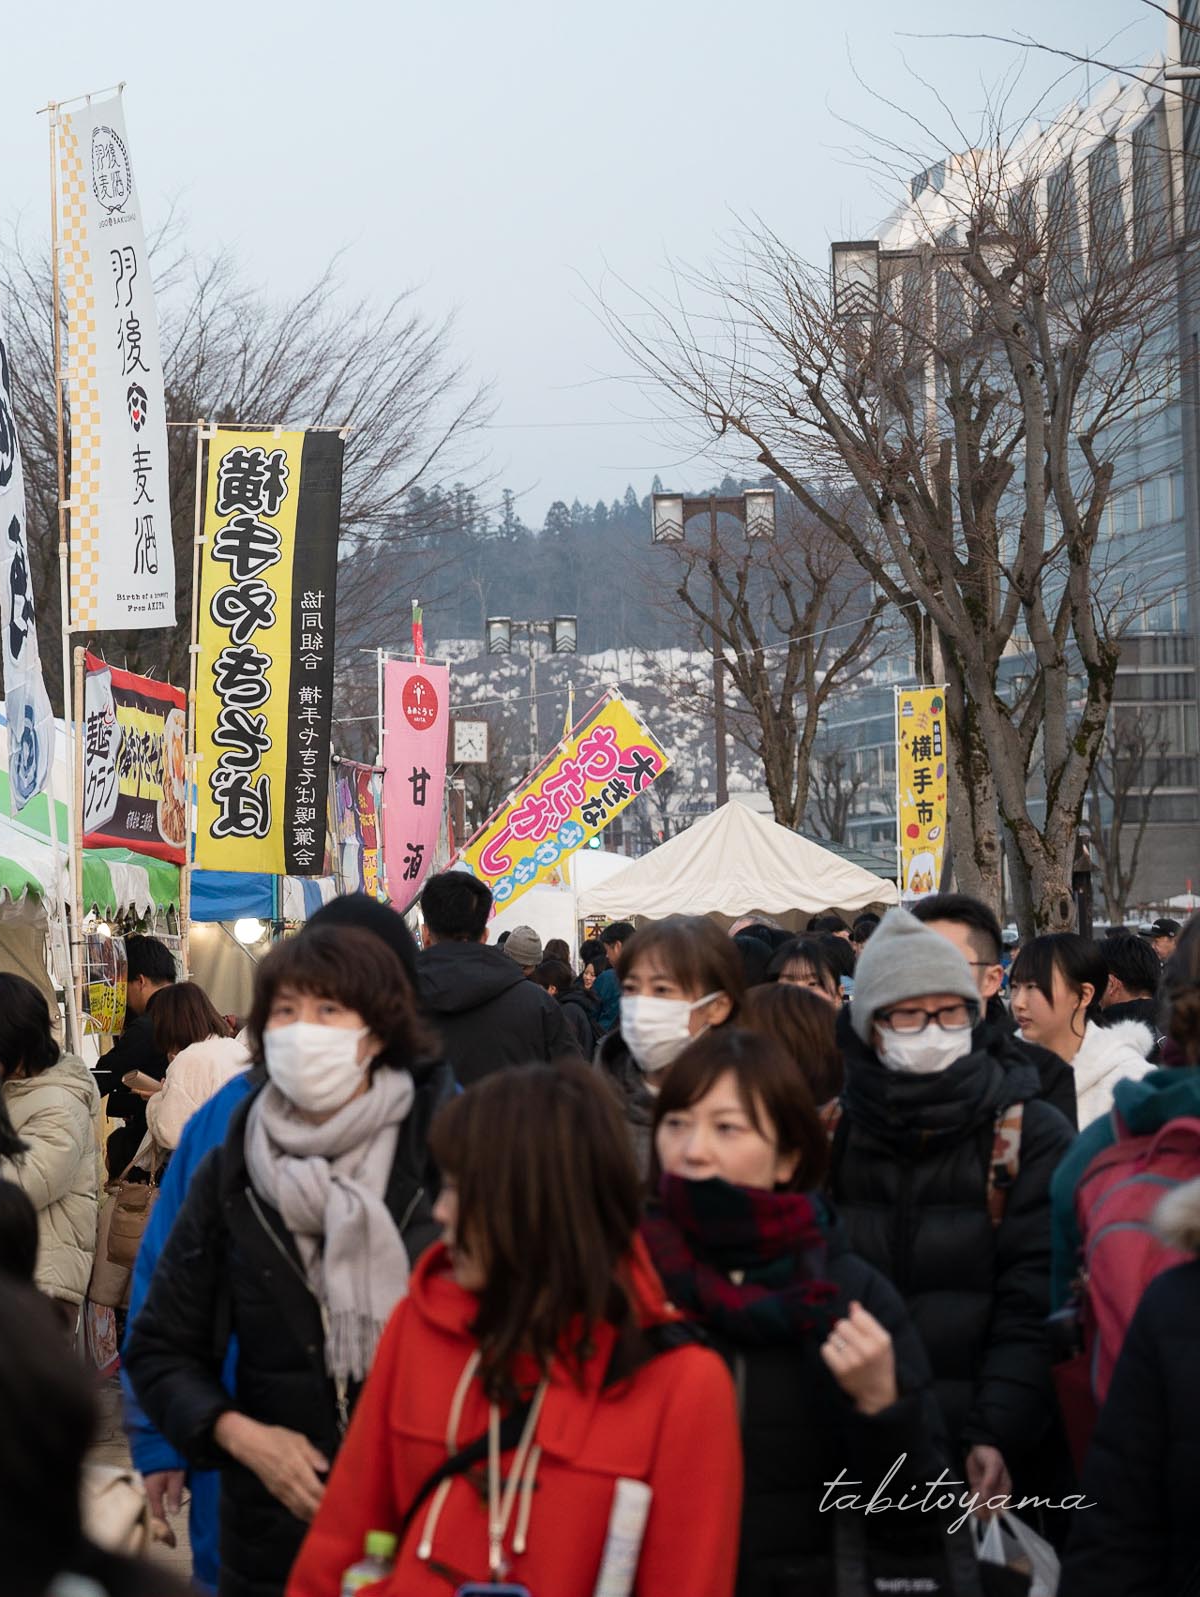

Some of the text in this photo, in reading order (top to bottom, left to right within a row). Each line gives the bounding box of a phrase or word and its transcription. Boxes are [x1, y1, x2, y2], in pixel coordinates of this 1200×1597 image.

[402, 766, 432, 881] 甘酒
[479, 724, 621, 878] わたがし
[581, 751, 657, 827] 大きな
[912, 735, 934, 826] 横手市
